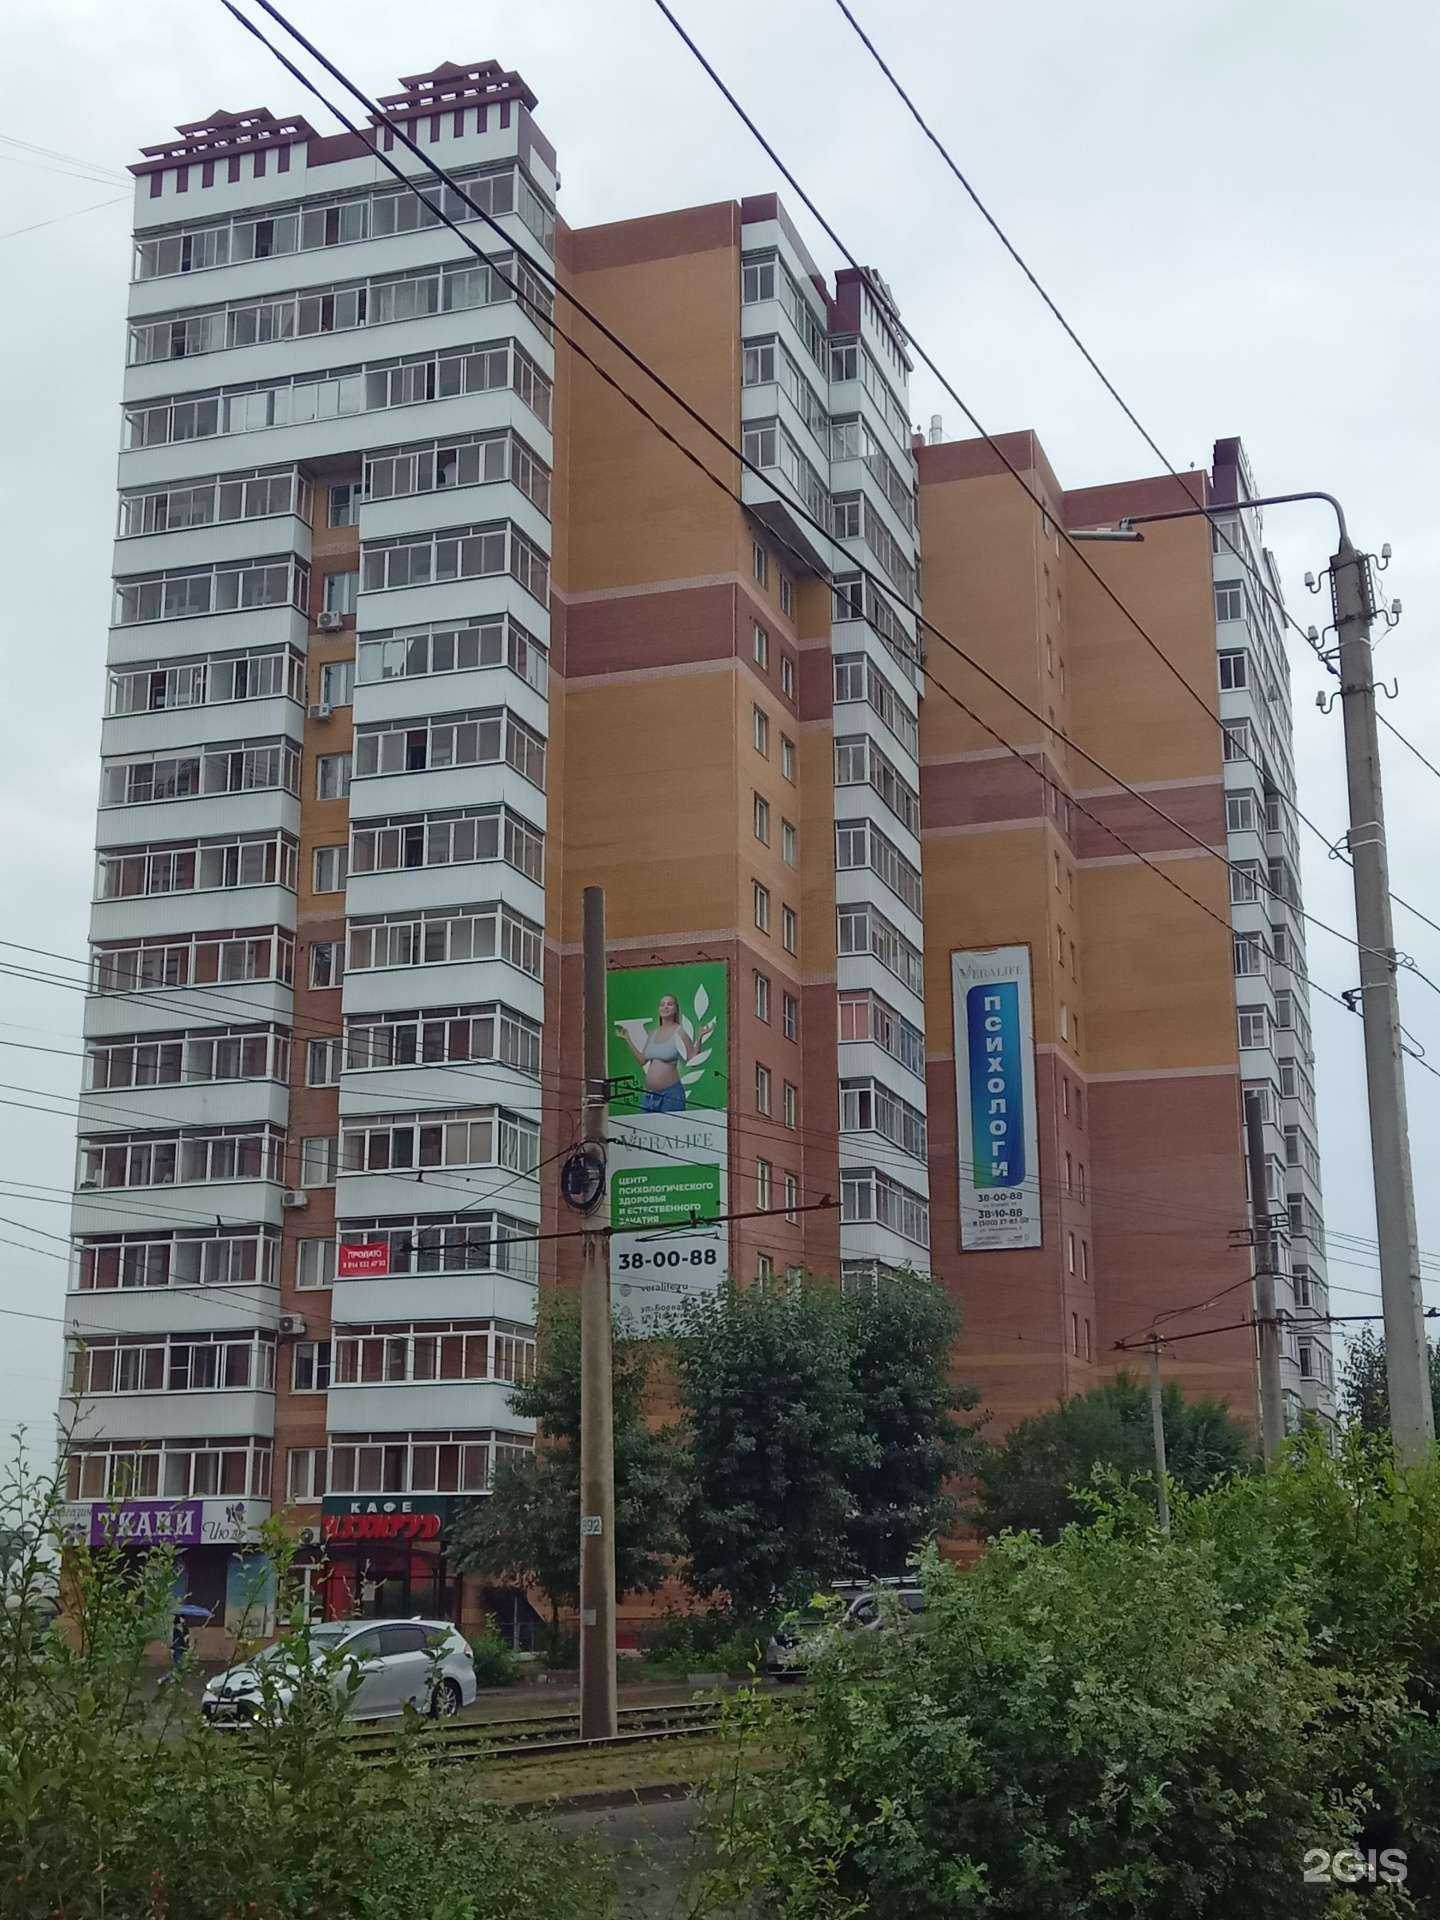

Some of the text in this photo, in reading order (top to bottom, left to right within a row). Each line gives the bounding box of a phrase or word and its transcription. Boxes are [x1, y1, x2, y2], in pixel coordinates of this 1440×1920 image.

[983, 995, 1008, 1178] ПСИХОЛОГИ
[618, 1176, 648, 1186] ЦЕНТР
[618, 1182, 714, 1195] ПСИХОЛОГИЧЕСКОГО
[618, 1195, 667, 1206] ЗДОРОВЬЯ
[627, 1203, 701, 1215] ЕСТЕСТВЕННОГО
[618, 1248, 717, 1270] 38-00-88
[350, 1501, 412, 1514] КАФЕ
